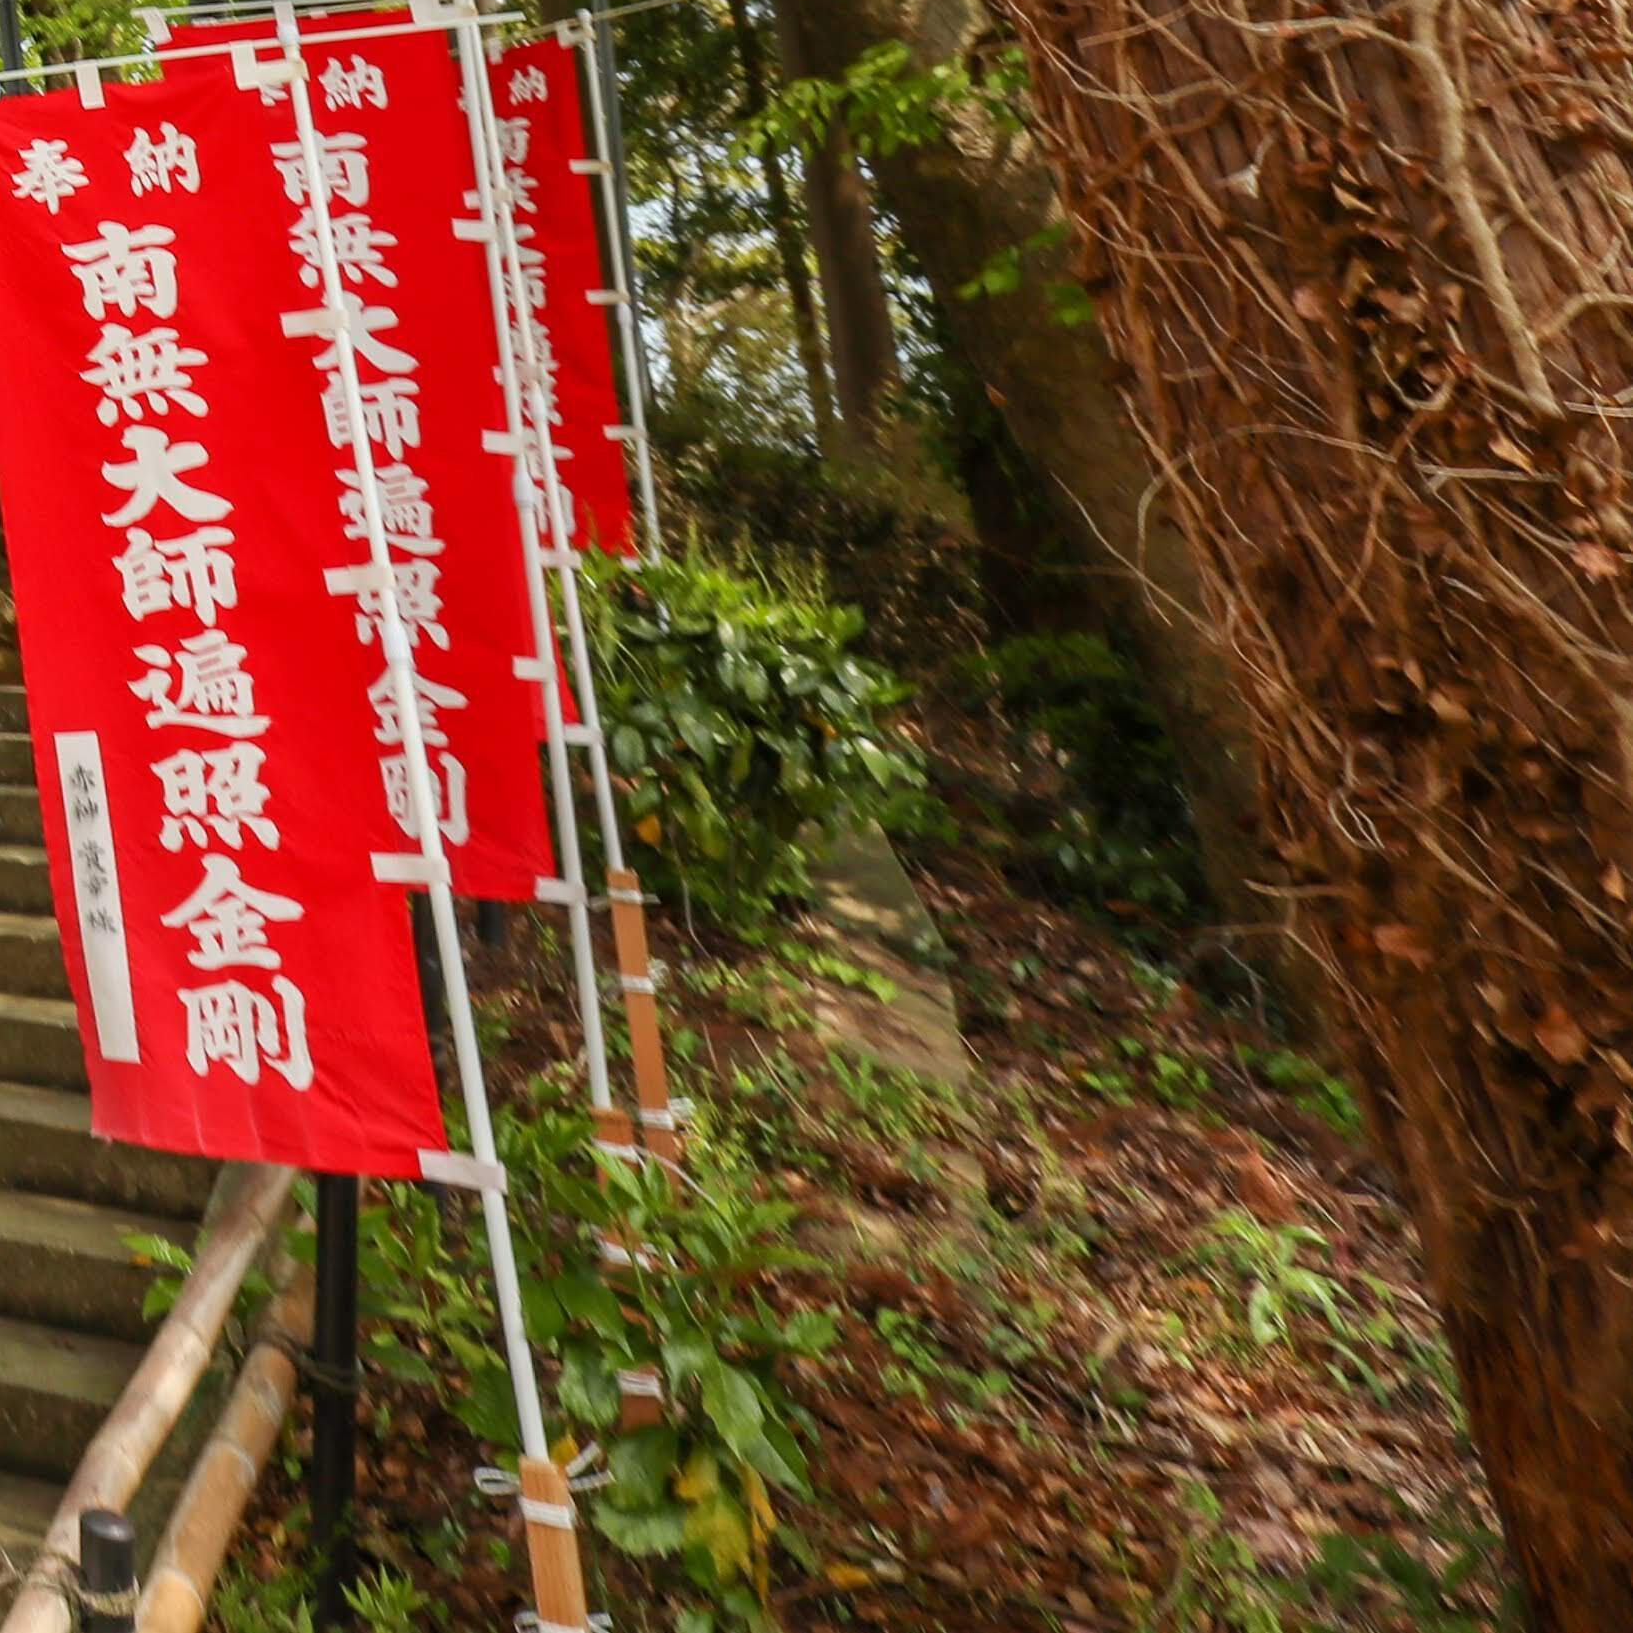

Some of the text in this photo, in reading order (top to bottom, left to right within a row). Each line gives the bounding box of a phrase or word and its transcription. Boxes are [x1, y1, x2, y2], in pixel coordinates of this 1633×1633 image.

[11, 121, 201, 215] 奉納
[61, 220, 315, 1091] 南無大師遍照金剛
